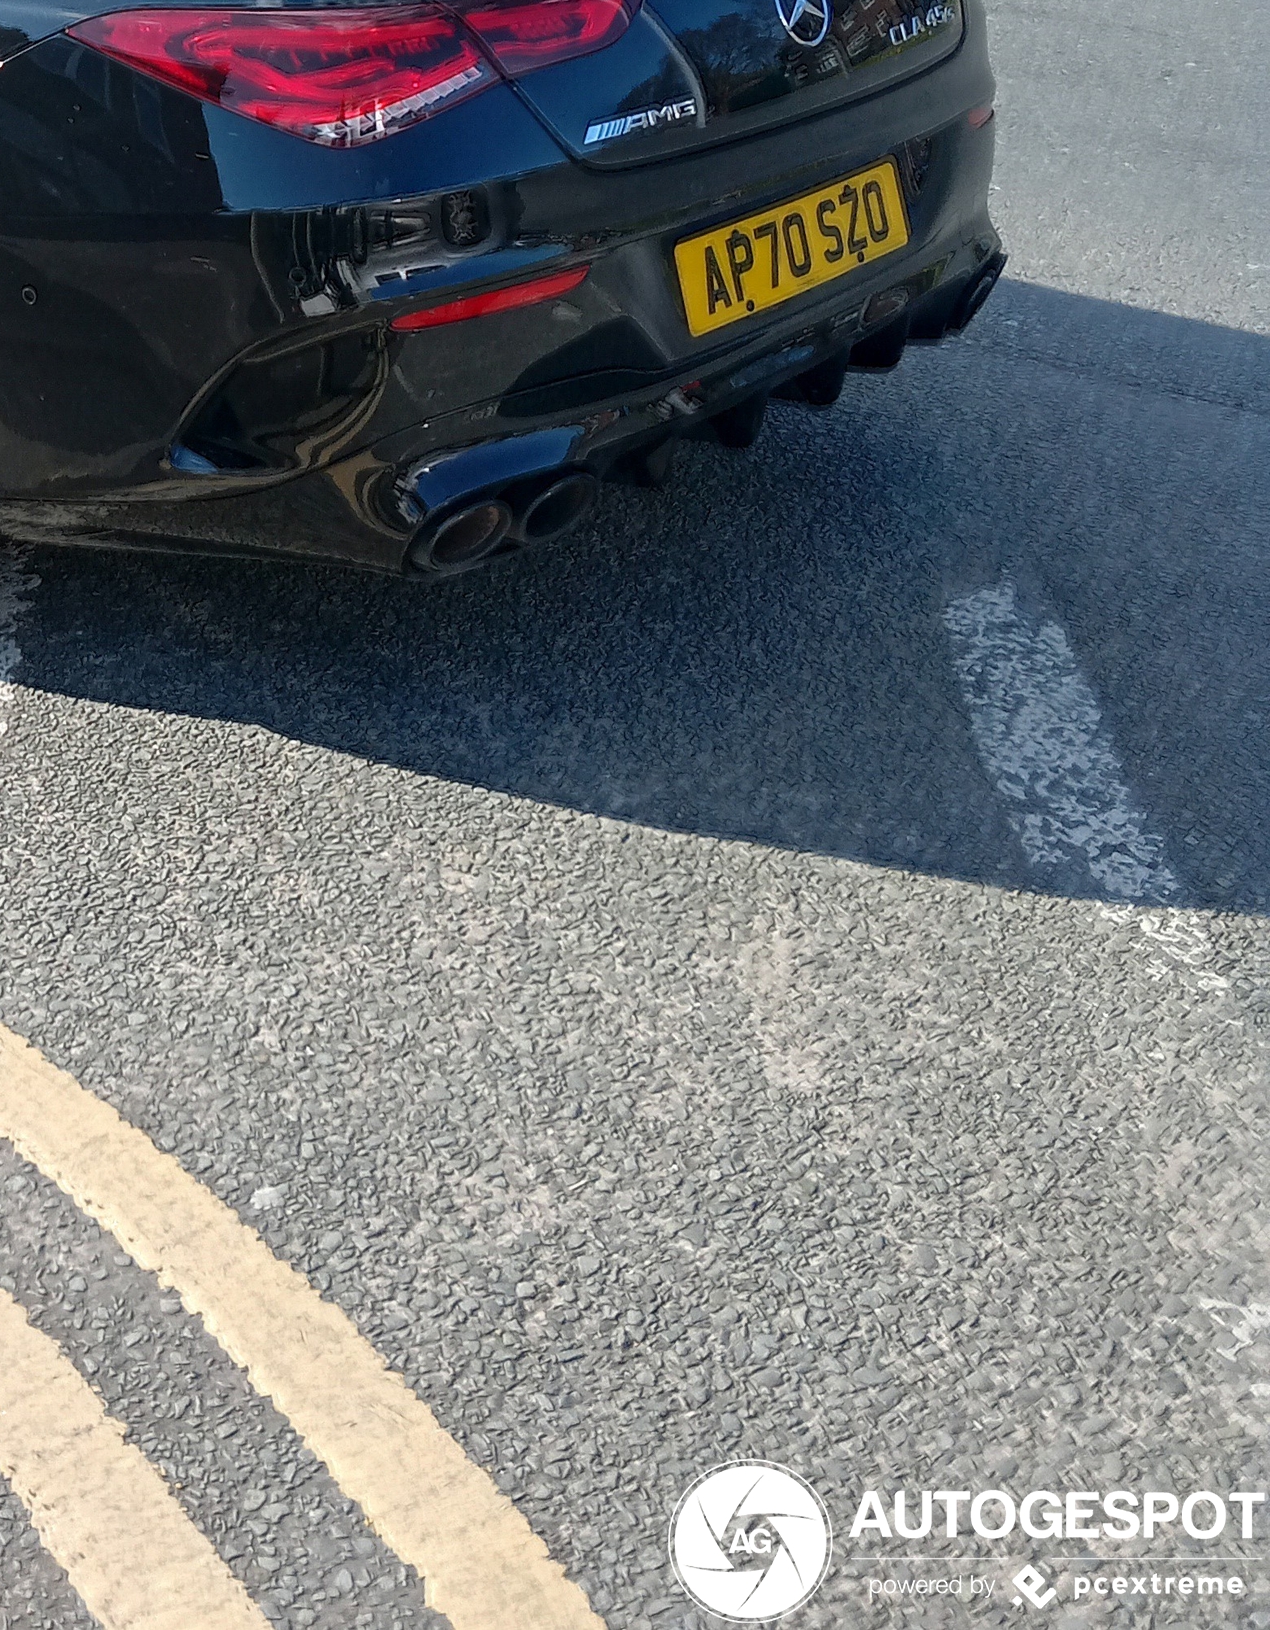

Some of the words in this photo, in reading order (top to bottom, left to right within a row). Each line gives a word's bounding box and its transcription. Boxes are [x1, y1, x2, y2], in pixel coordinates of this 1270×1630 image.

[889, 16, 926, 46] CLA
[622, 98, 697, 135] AMG
[704, 212, 813, 316] AP70
